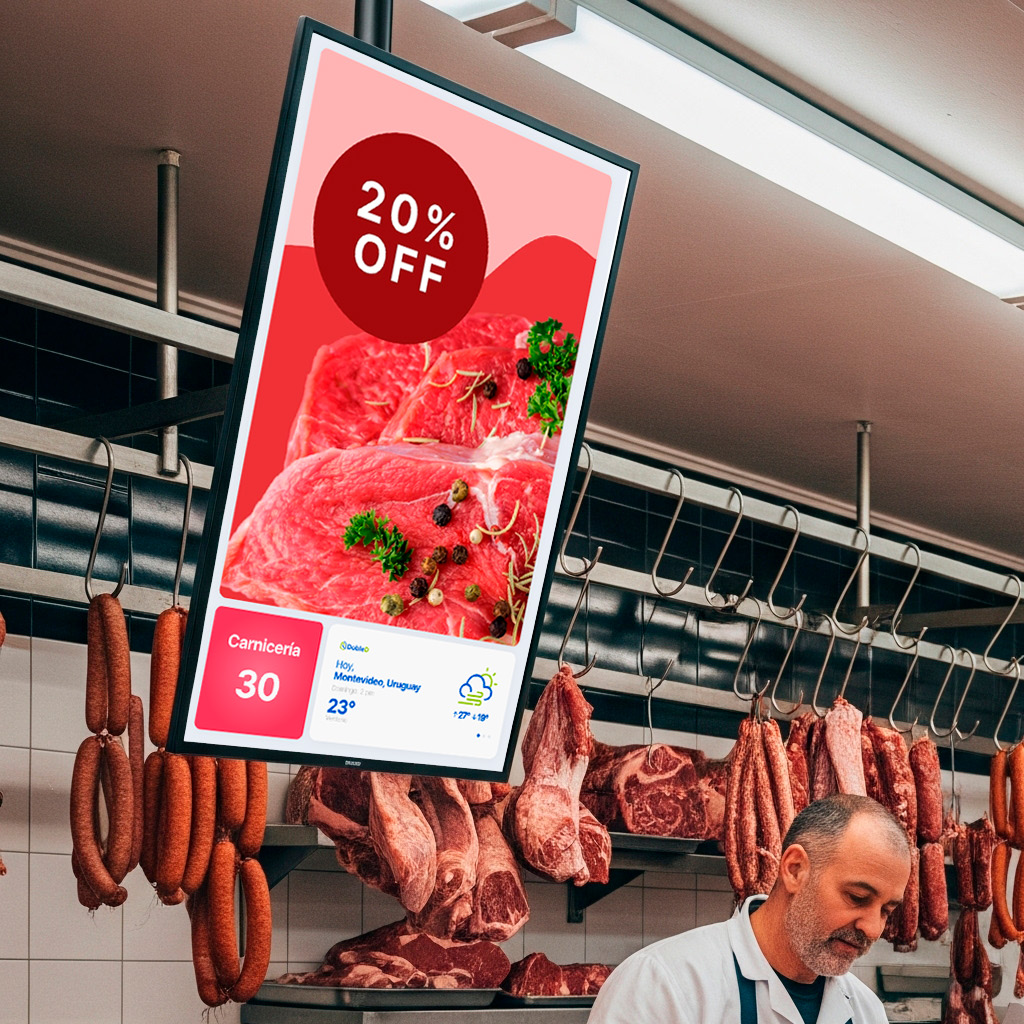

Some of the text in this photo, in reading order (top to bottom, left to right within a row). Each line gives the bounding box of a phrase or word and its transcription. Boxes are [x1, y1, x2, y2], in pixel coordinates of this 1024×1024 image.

[357, 180, 456, 250] 20%
[354, 233, 447, 293] OFF
[228, 633, 301, 657] Carnicería
[335, 659, 355, 672] Hoy,
[235, 669, 280, 702] 30
[333, 671, 421, 693] Montevideo, Uruguay
